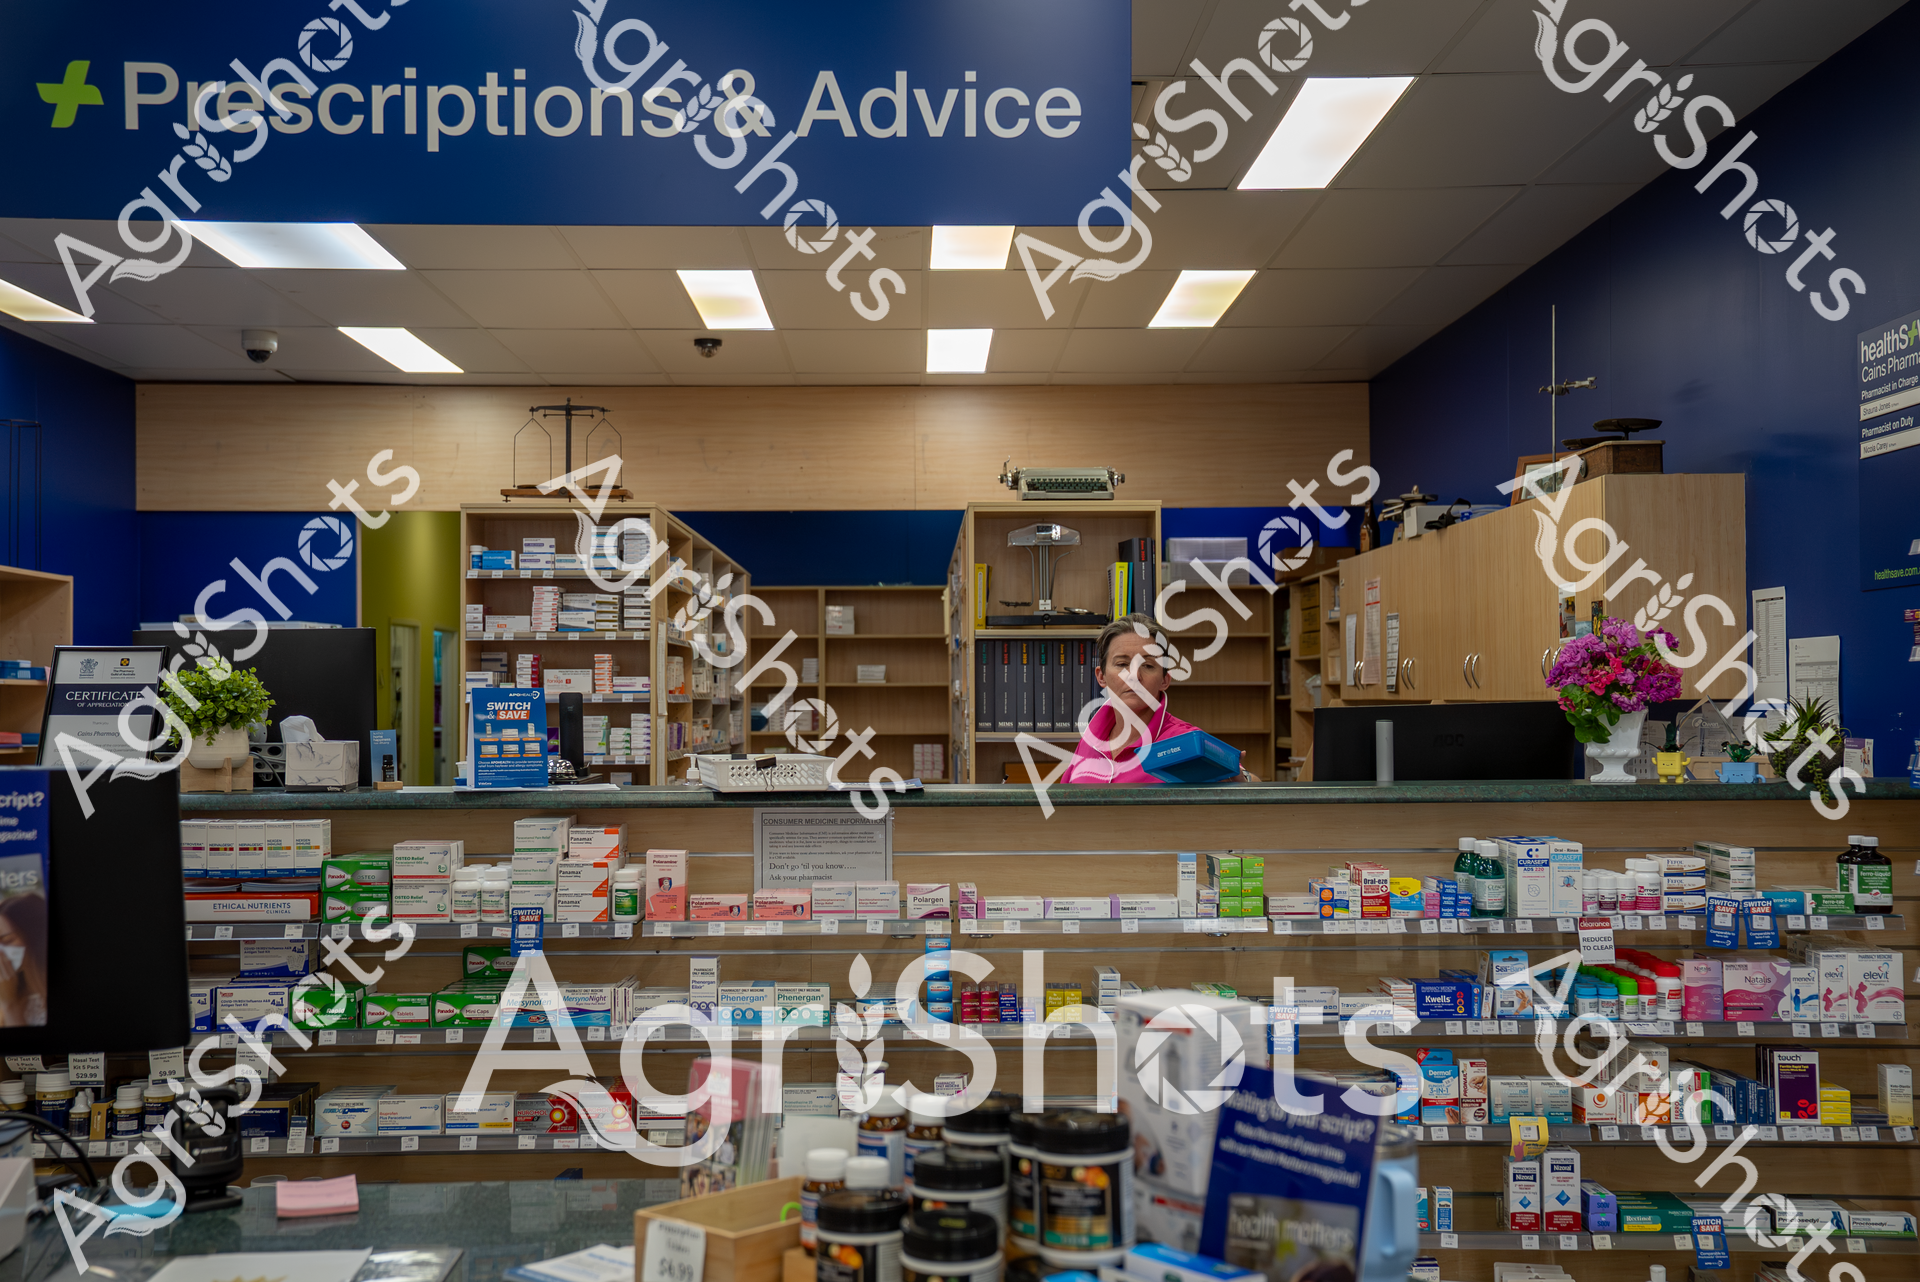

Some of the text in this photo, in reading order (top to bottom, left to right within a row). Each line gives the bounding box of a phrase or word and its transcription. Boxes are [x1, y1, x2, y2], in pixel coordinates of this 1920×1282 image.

[123, 61, 1083, 153] Prescriptions & Advice
[1861, 362, 1887, 383] Cains
[1861, 375, 1919, 400] Pharmacist in Charge
[1861, 416, 1914, 438] Pharmacist on Duty
[65, 691, 143, 701] CERTIFICATE
[486, 702, 530, 710] SWITCH
[487, 711, 528, 719] & SAVE
[769, 874, 832, 882] Ask your pharmacist
[1709, 899, 1738, 907] SWITCH
[1824, 970, 1843, 979] elevit
[1863, 970, 1890, 980] elevit
[1744, 976, 1771, 984] Natalis
[563, 995, 606, 1003] MersynoNight
[721, 995, 765, 1003] Phenergan
[778, 994, 821, 1002] Phenergan
[1425, 995, 1450, 1003] Kwells
[1692, 1218, 1720, 1226] SWITCH
